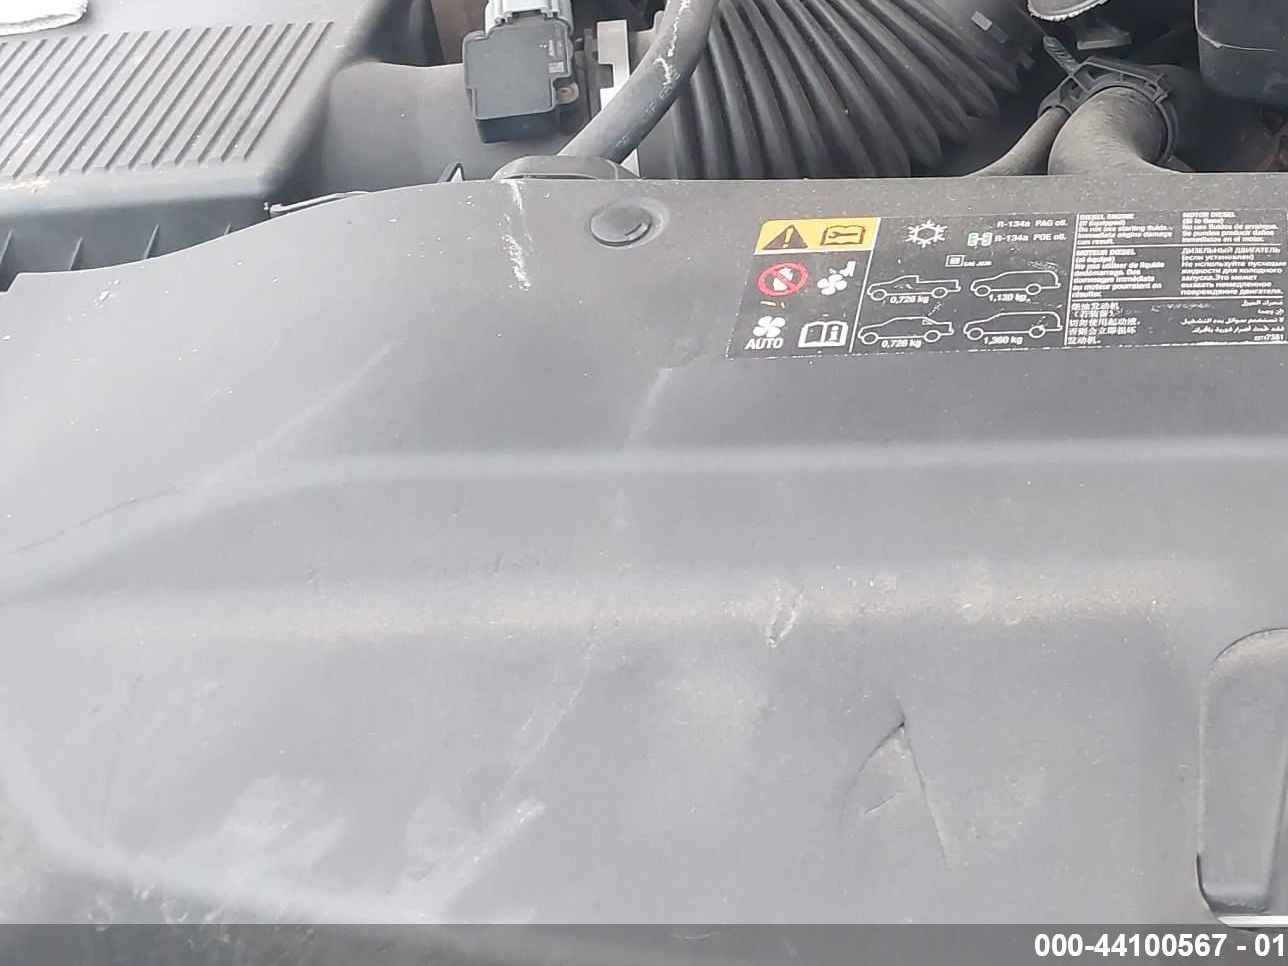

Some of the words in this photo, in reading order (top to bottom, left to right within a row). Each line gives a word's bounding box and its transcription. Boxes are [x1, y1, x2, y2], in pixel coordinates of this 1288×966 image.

[996, 220, 1031, 228] R-134a
[1034, 219, 1053, 227] PAG
[994, 234, 1029, 242] R-134a
[1032, 233, 1052, 241] POE
[1109, 248, 1136, 256] DIESEL
[1234, 246, 1281, 254] ДВИГАТЕЛЬ
[1086, 263, 1100, 271] pas
[1140, 261, 1165, 269] liquide
[1194, 261, 1246, 269] используйте
[1111, 283, 1151, 291] pourraient
[917, 296, 930, 305] kg
[1014, 294, 1027, 303] kg
[744, 337, 784, 350] AUTO
[909, 339, 922, 348] kg
[1010, 336, 1023, 345] kg
